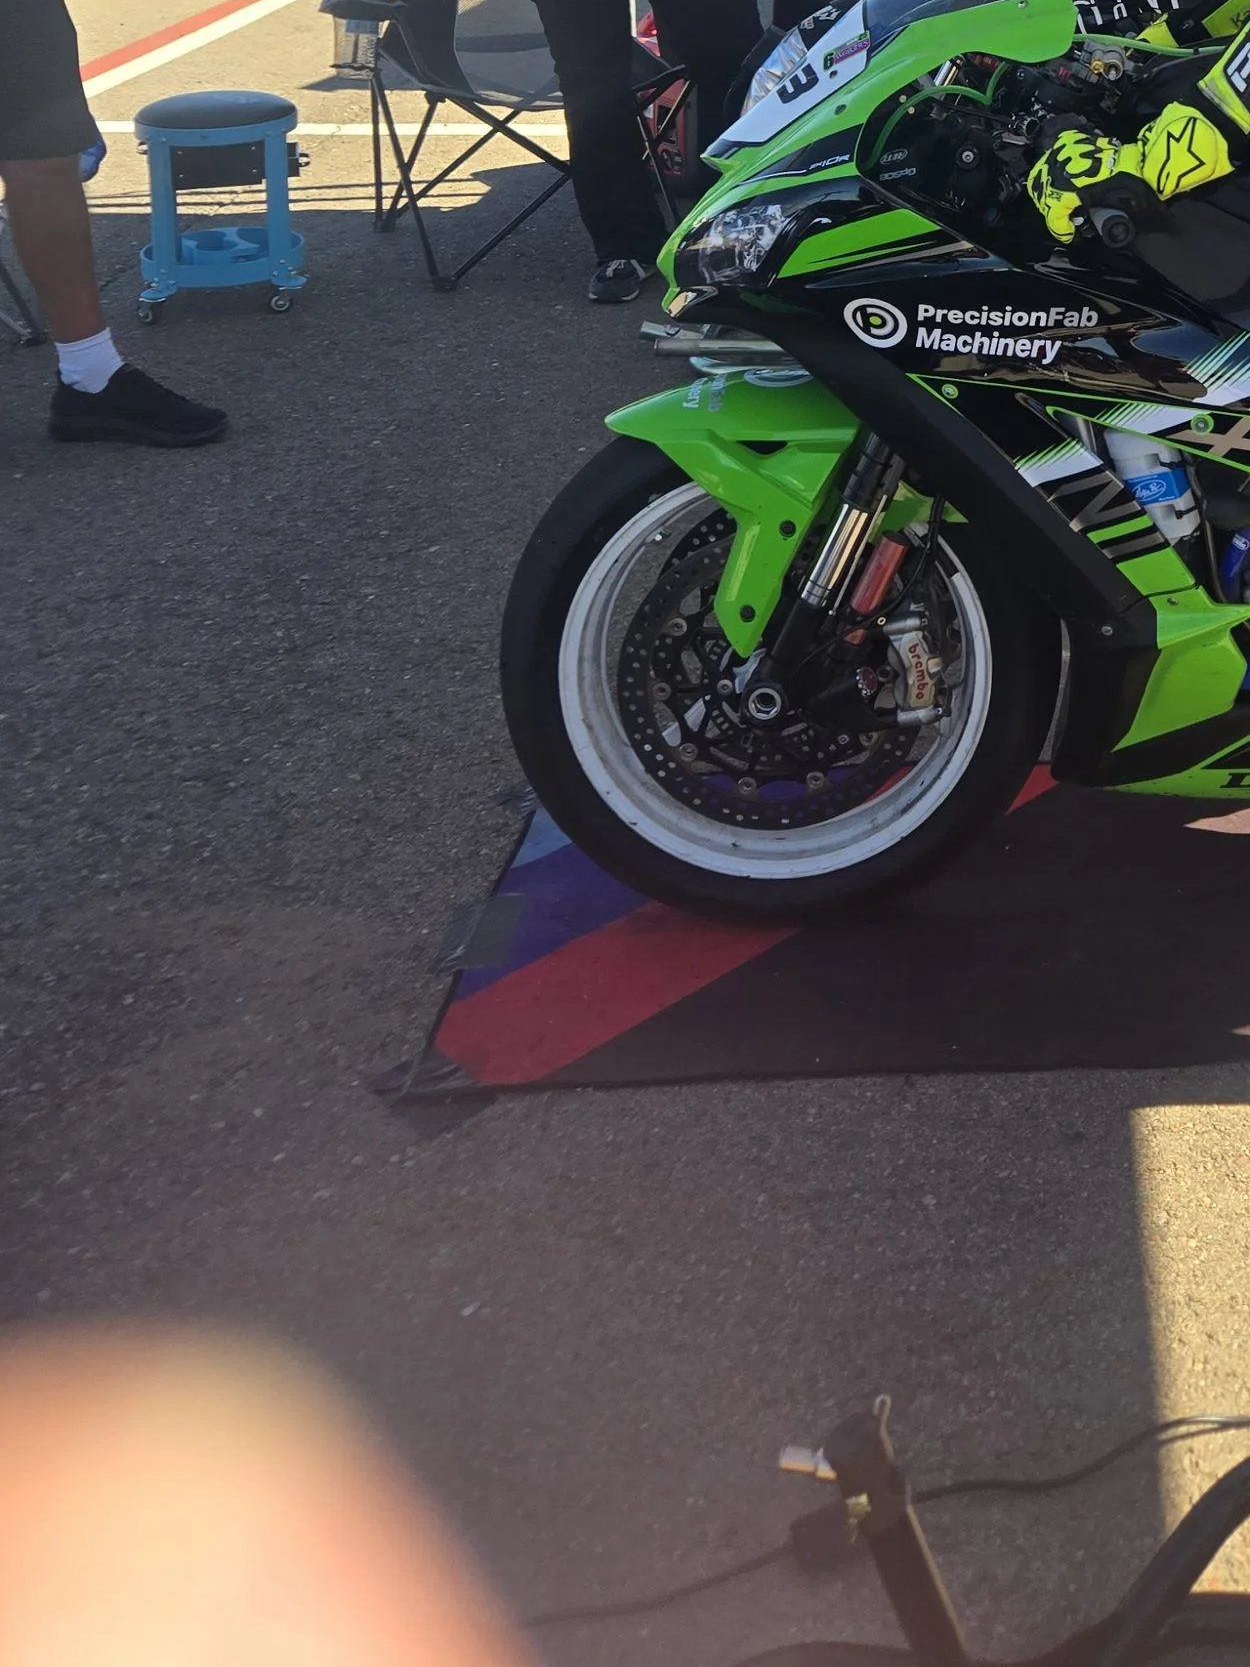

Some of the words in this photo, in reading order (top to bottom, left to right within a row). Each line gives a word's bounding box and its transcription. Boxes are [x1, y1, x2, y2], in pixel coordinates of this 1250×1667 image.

[916, 304, 1099, 329] PrecisionFab
[915, 326, 1062, 366] Machinery
[908, 642, 929, 701] brembo
